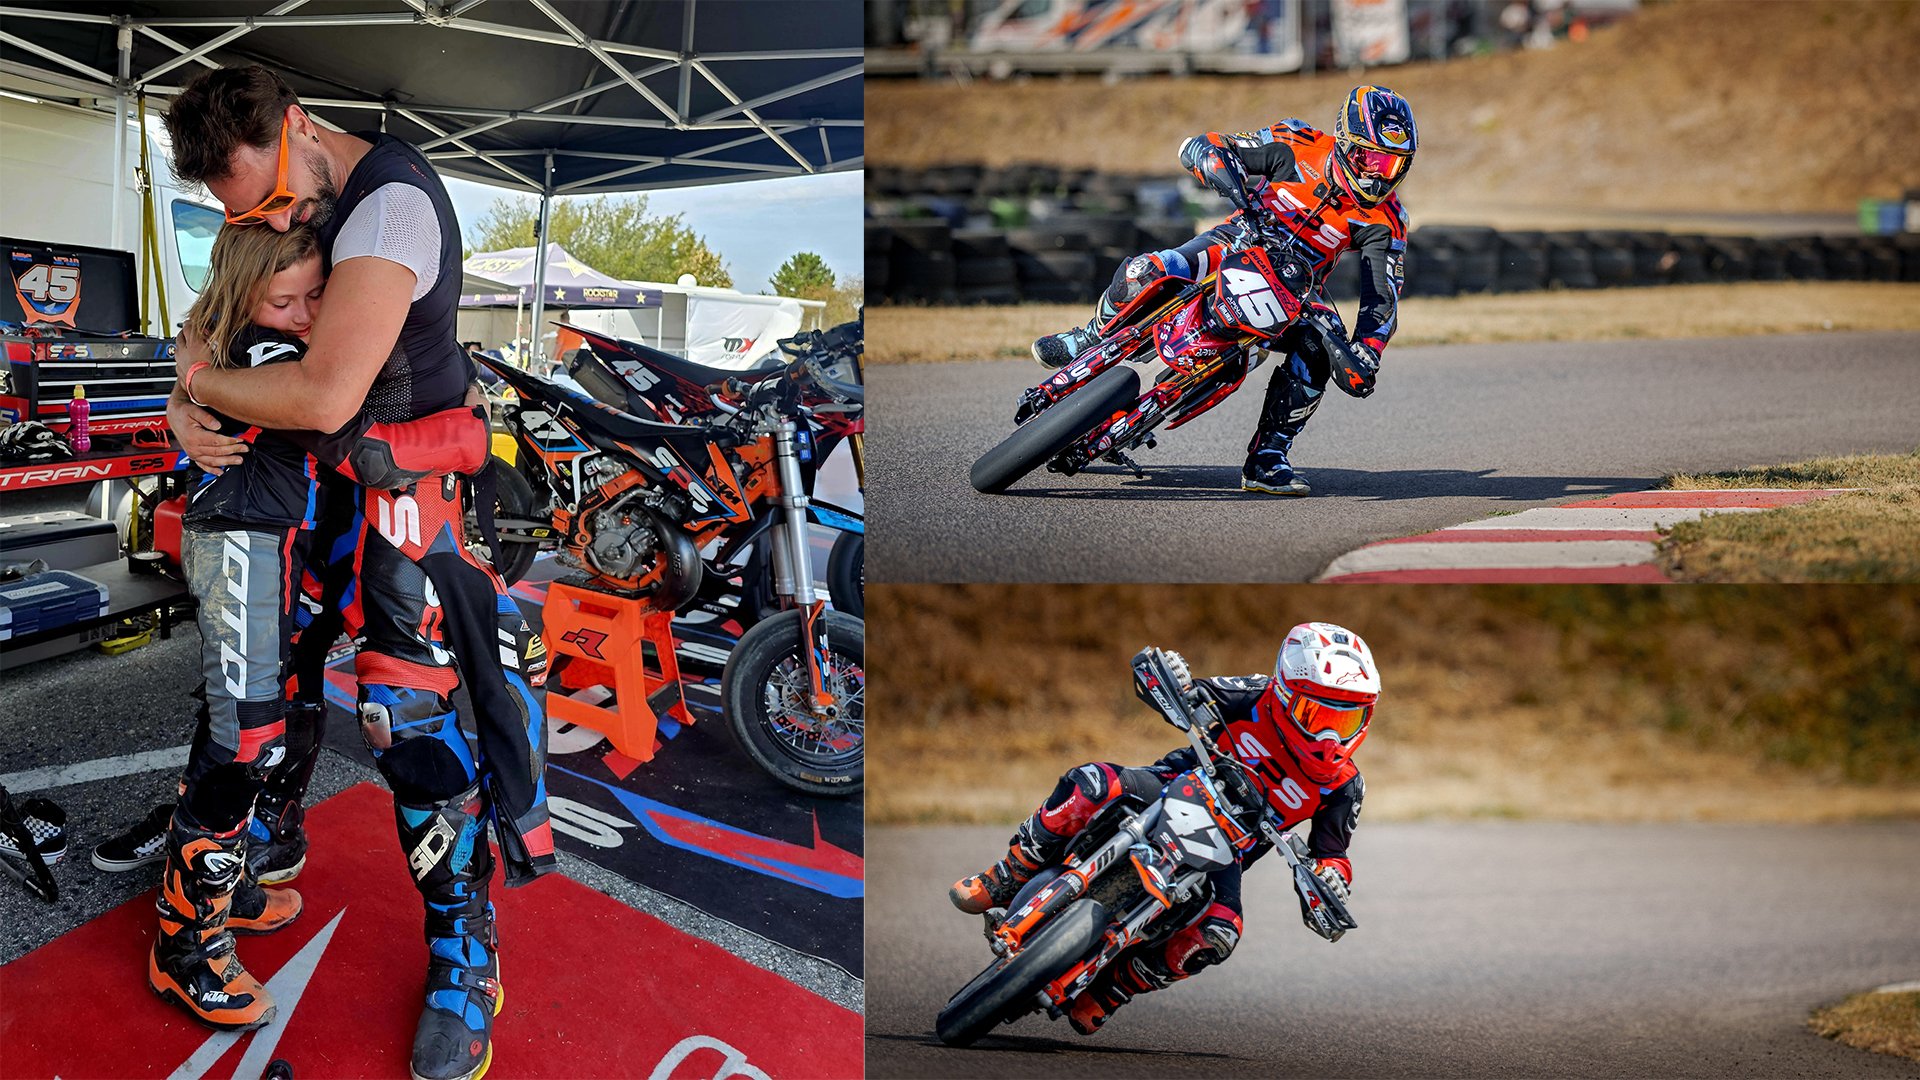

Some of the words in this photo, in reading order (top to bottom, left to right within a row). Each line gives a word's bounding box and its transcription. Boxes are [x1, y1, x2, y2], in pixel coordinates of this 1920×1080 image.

[1249, 250, 1271, 276] DUCATI
[19, 266, 79, 301] 45
[1221, 267, 1289, 328] 45
[50, 345, 89, 358] SPS
[611, 360, 661, 392] 45
[520, 411, 572, 440] 47
[648, 446, 714, 514] SPS
[706, 476, 743, 505] KTM
[222, 530, 250, 700] OTO
[1151, 687, 1173, 711] TECH
[1235, 732, 1311, 810] SPS
[1160, 832, 1184, 861] SPS
[1163, 798, 1235, 866] 47
[202, 990, 230, 1004] KTM
